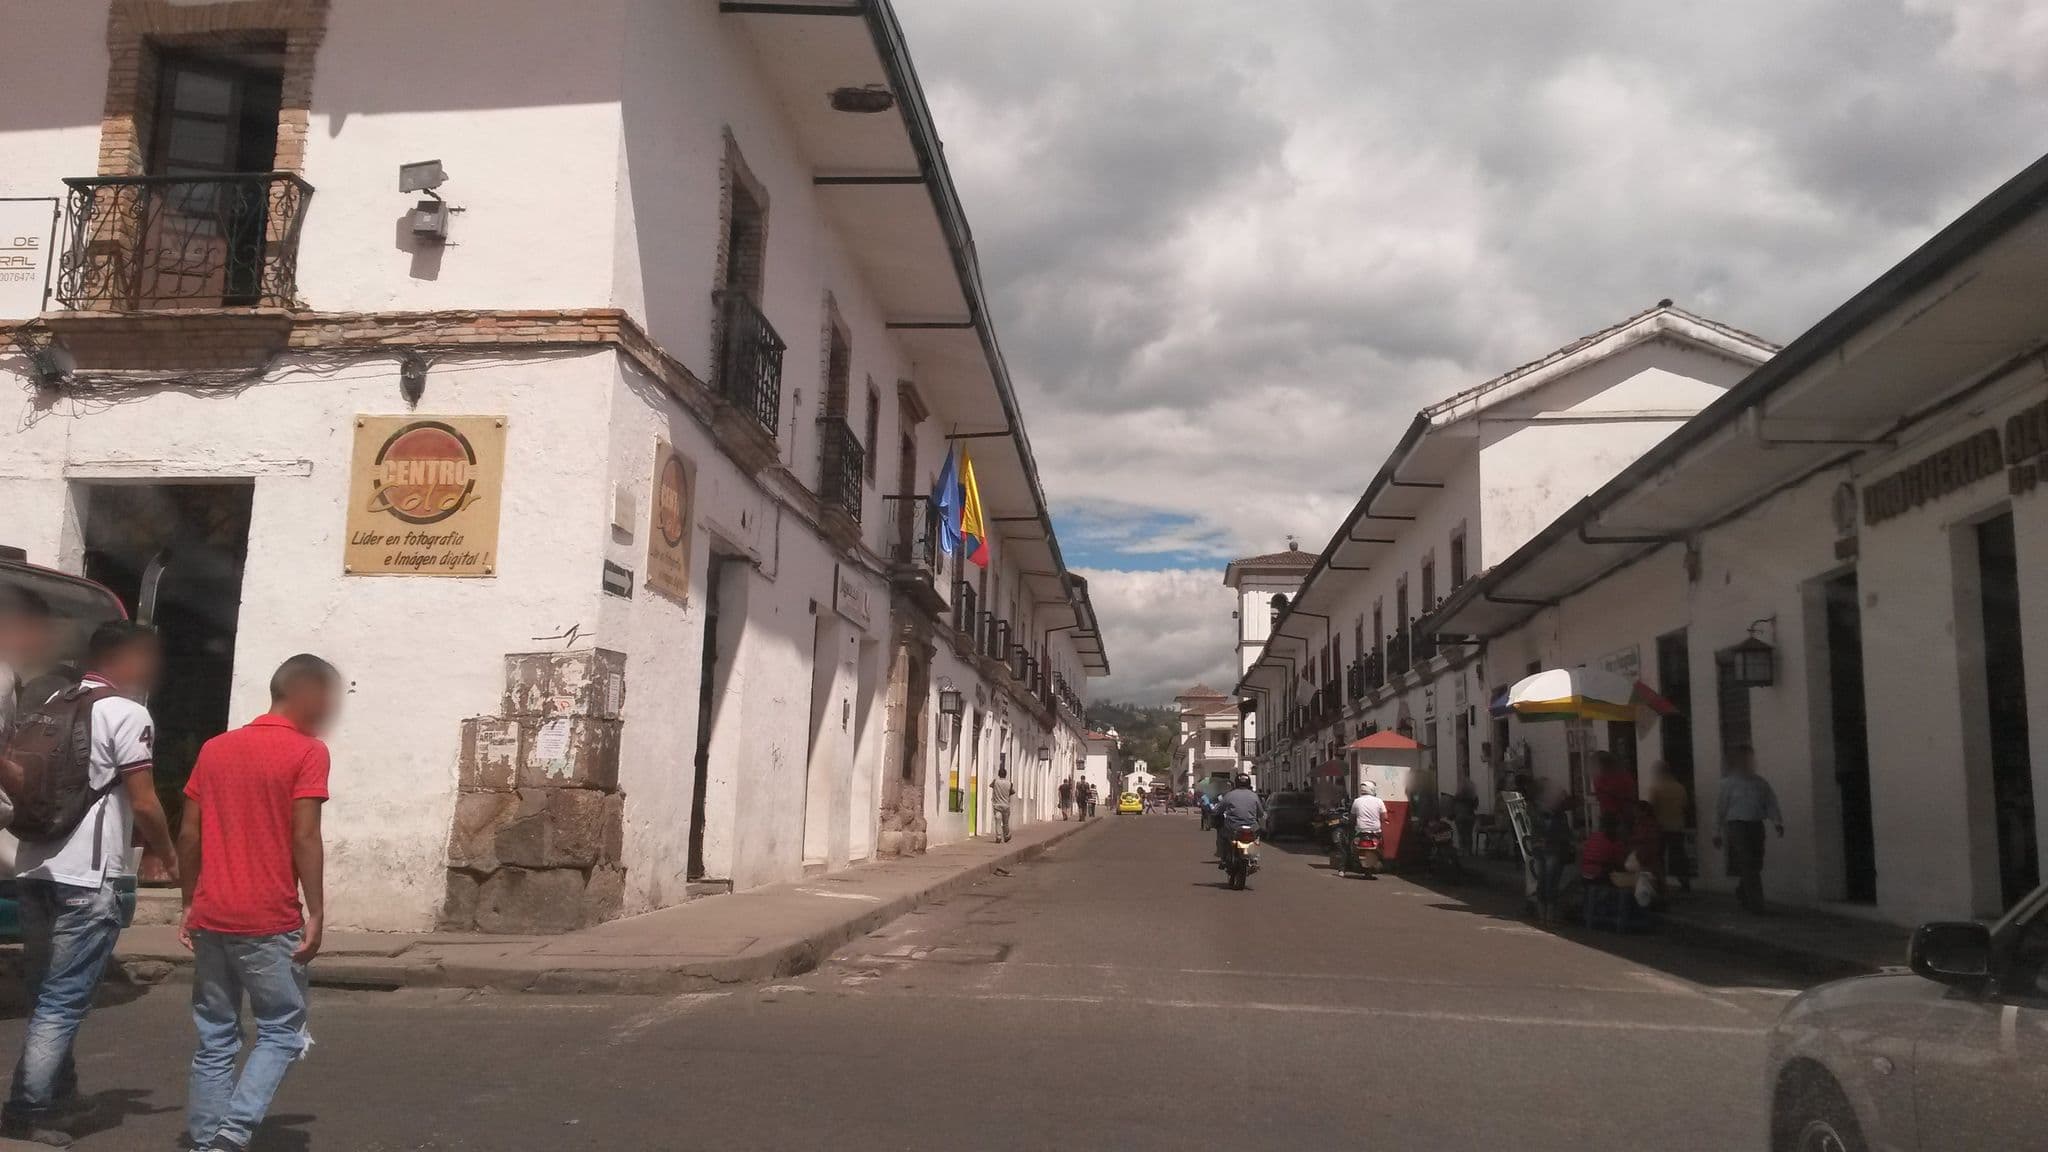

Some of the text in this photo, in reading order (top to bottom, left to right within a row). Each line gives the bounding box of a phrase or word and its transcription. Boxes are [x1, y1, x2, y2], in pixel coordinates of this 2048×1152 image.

[13, 236, 40, 247] DE
[381, 458, 470, 486] CENTRO
[385, 535, 400, 545] en
[384, 554, 392, 565] e
[138, 725, 152, 749] 4
